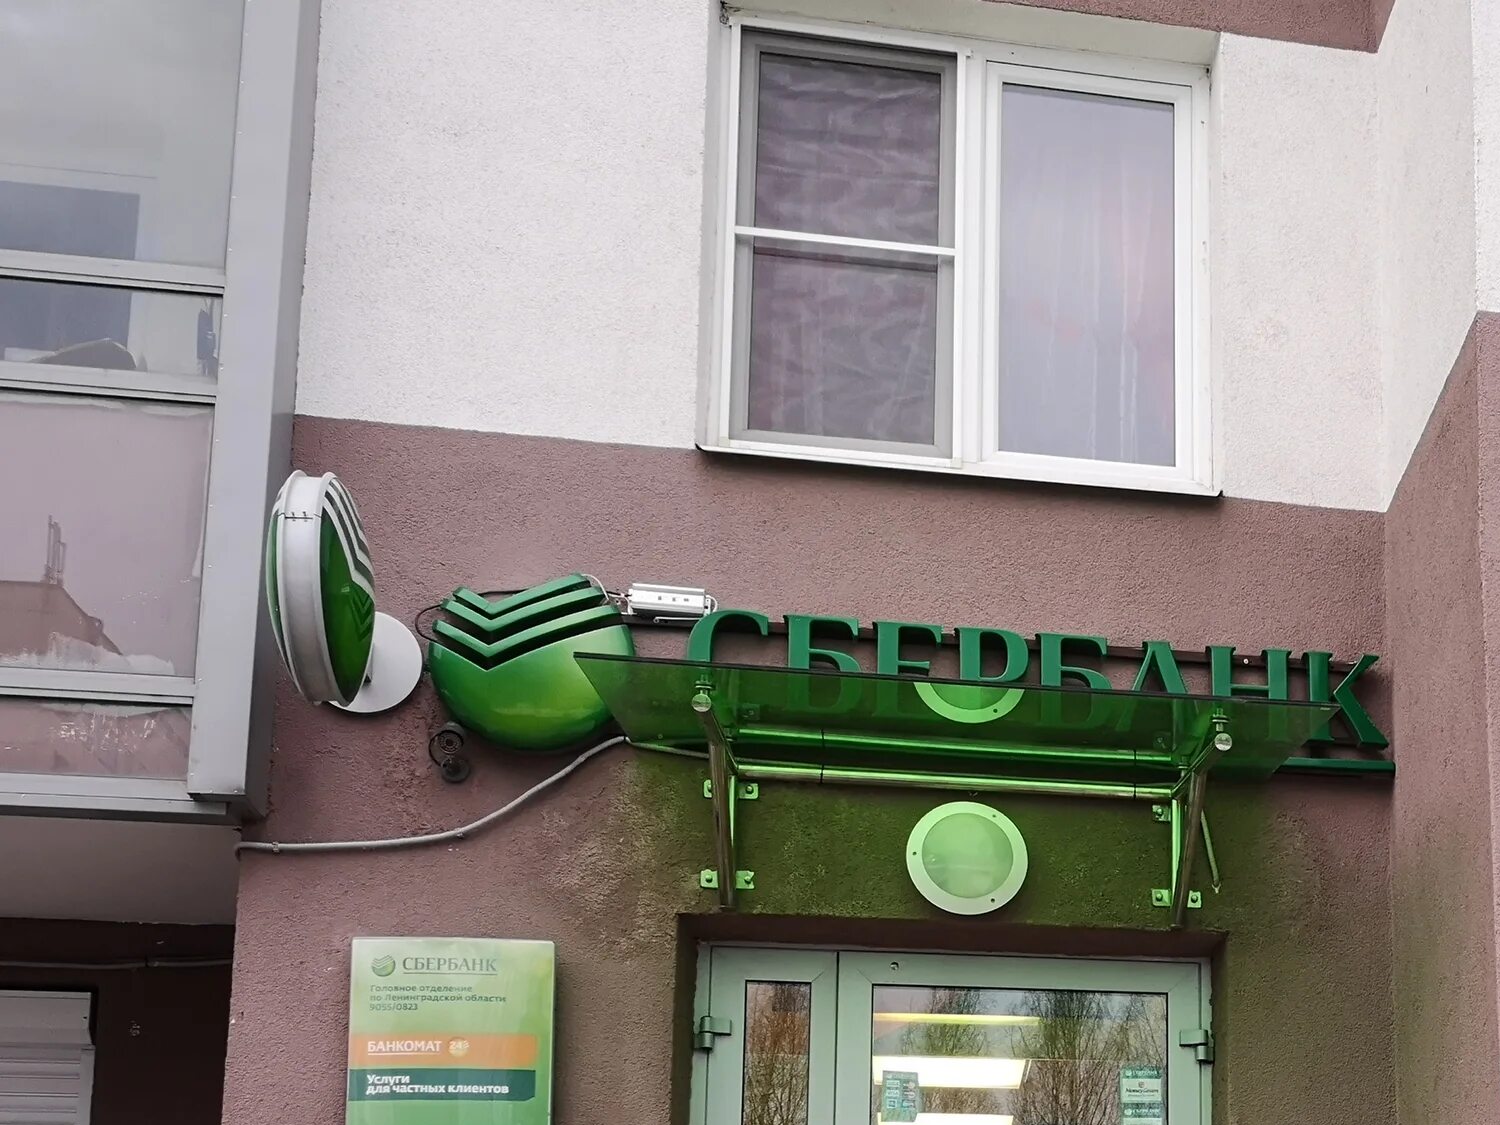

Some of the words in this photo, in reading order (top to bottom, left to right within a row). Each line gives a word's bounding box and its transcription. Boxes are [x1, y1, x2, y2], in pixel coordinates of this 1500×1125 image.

[687, 608, 1390, 751] СБЕРБАНК
[402, 957, 497, 971] СБЕРБАНК
[370, 985, 416, 993] Головное
[419, 985, 472, 993] отделение
[385, 994, 463, 1002] Ленинградской
[466, 994, 506, 1003] области
[369, 1003, 418, 1011] 9055/0823
[367, 1040, 442, 1052] БАНКОМАТ
[366, 1074, 410, 1086] Услуги
[365, 1085, 390, 1095] для
[392, 1085, 445, 1093] частных
[447, 1085, 509, 1094] клиентов
